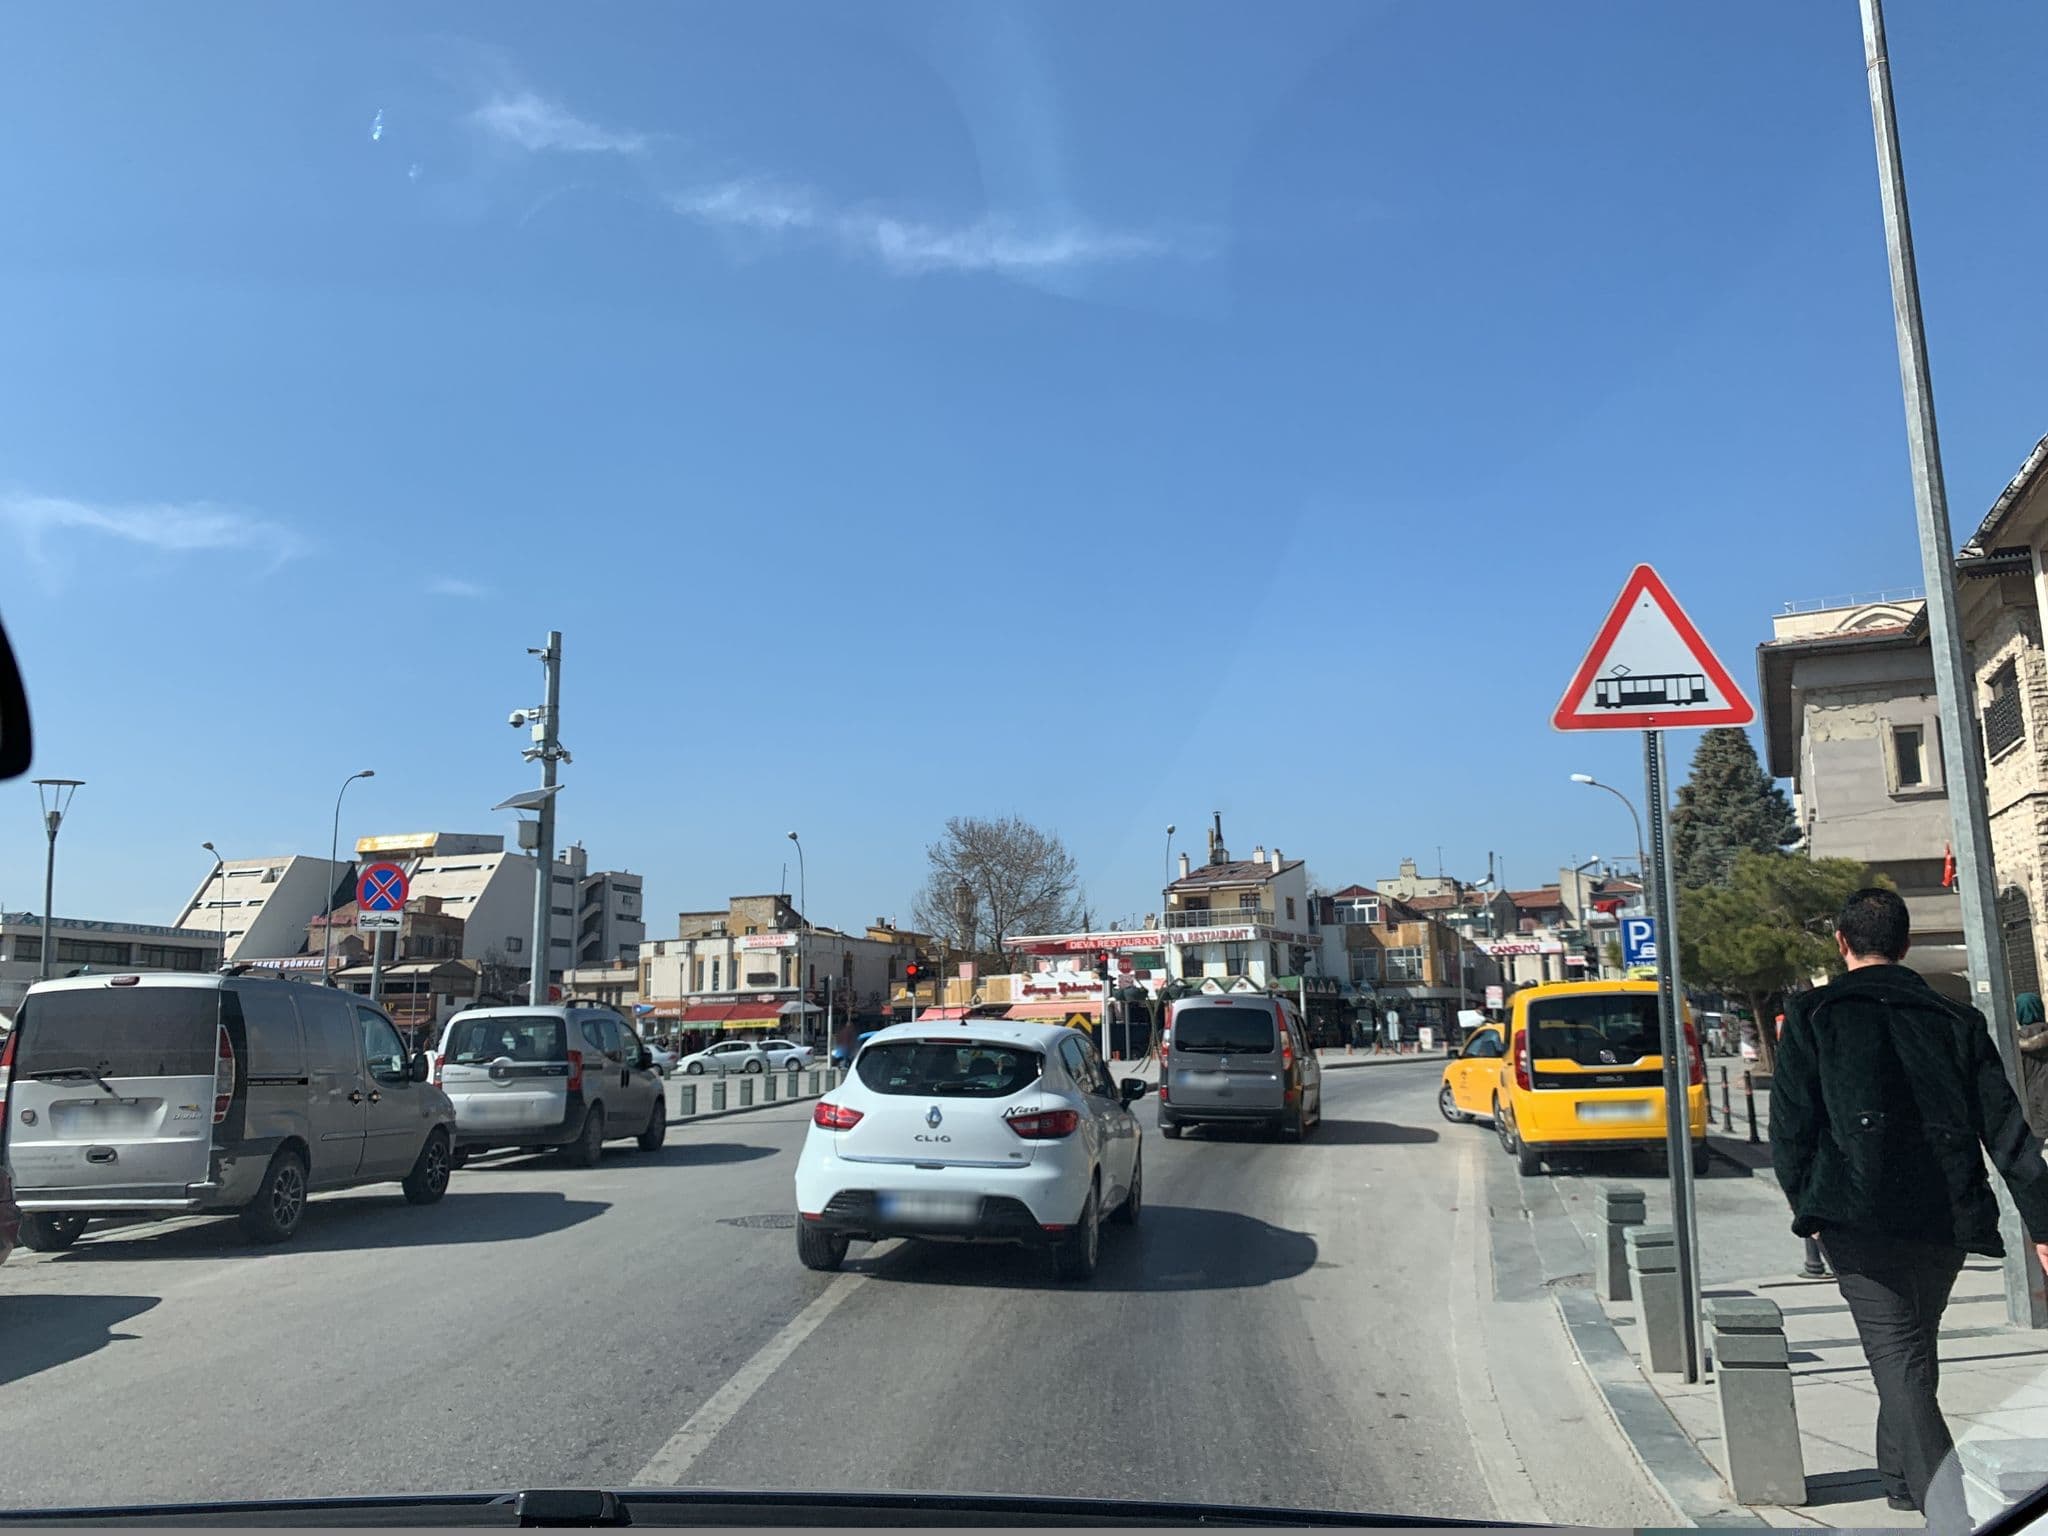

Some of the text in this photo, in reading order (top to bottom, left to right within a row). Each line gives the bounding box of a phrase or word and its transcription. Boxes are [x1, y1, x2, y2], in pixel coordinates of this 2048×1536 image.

[1187, 929, 1249, 942] RESTAURANT
[1628, 921, 1652, 951] P
[1070, 941, 1095, 949] DEVA
[1489, 943, 1541, 954] CANSUYU
[914, 1135, 952, 1143] CLIO
